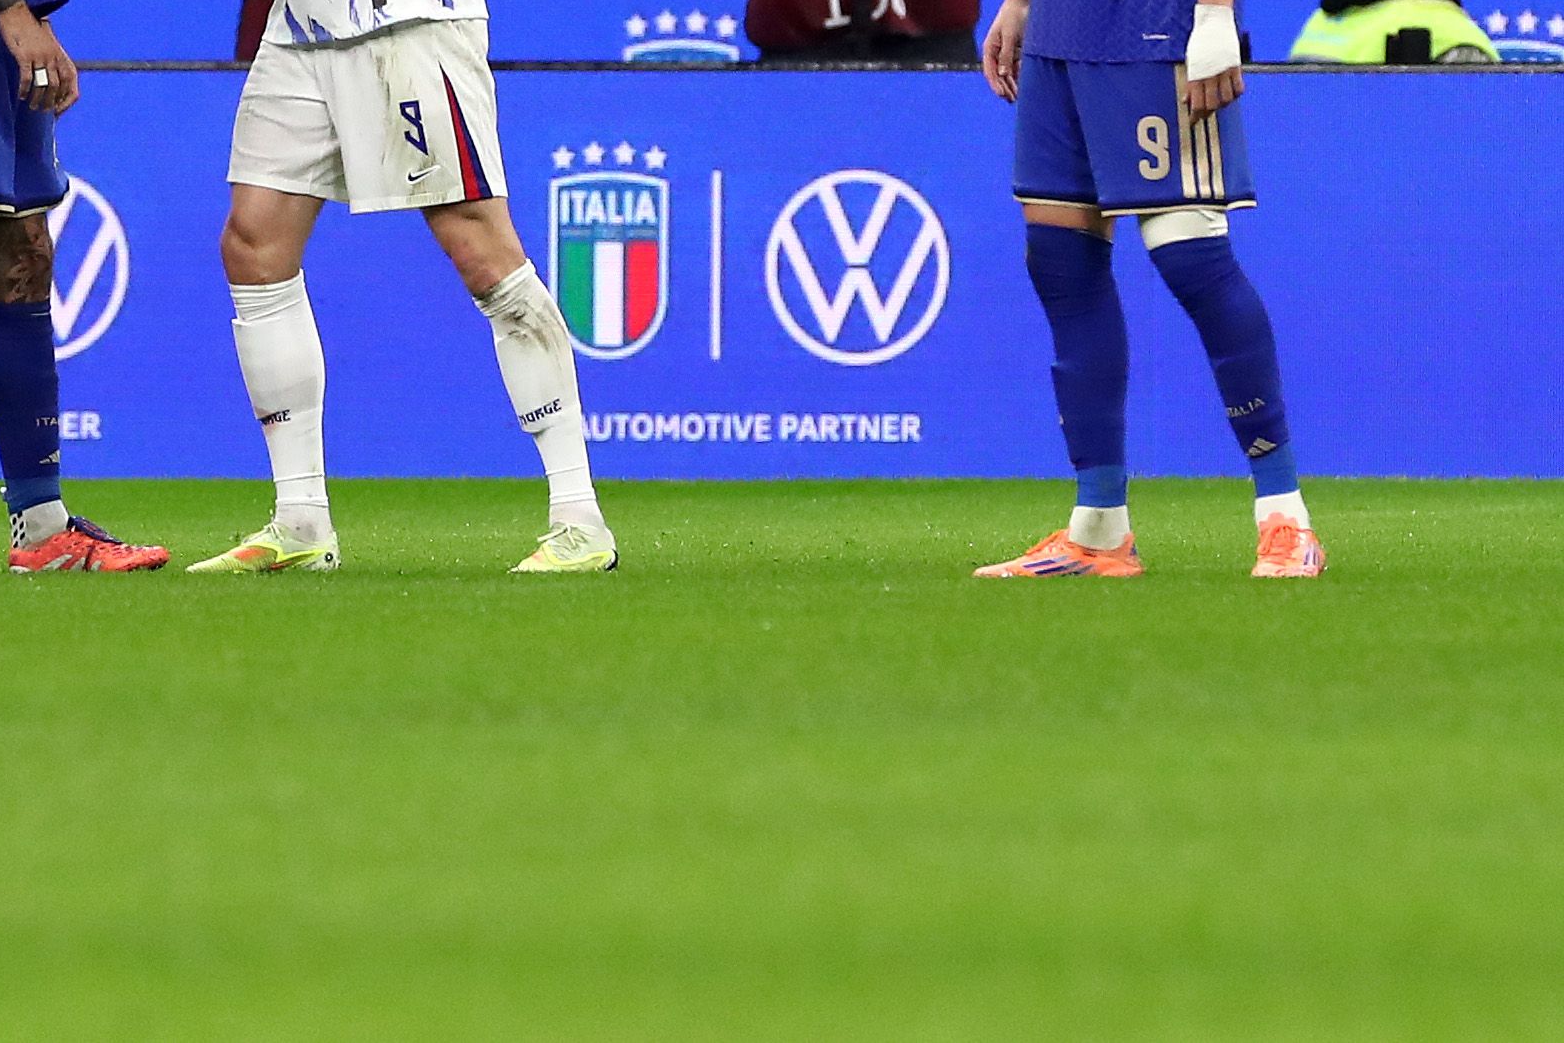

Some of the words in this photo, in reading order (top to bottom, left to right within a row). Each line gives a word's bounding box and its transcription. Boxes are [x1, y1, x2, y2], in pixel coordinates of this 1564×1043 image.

[399, 100, 429, 156] 9
[1137, 116, 1171, 181] 9
[560, 189, 657, 225] ITALIA
[778, 413, 922, 443] PARTNER
